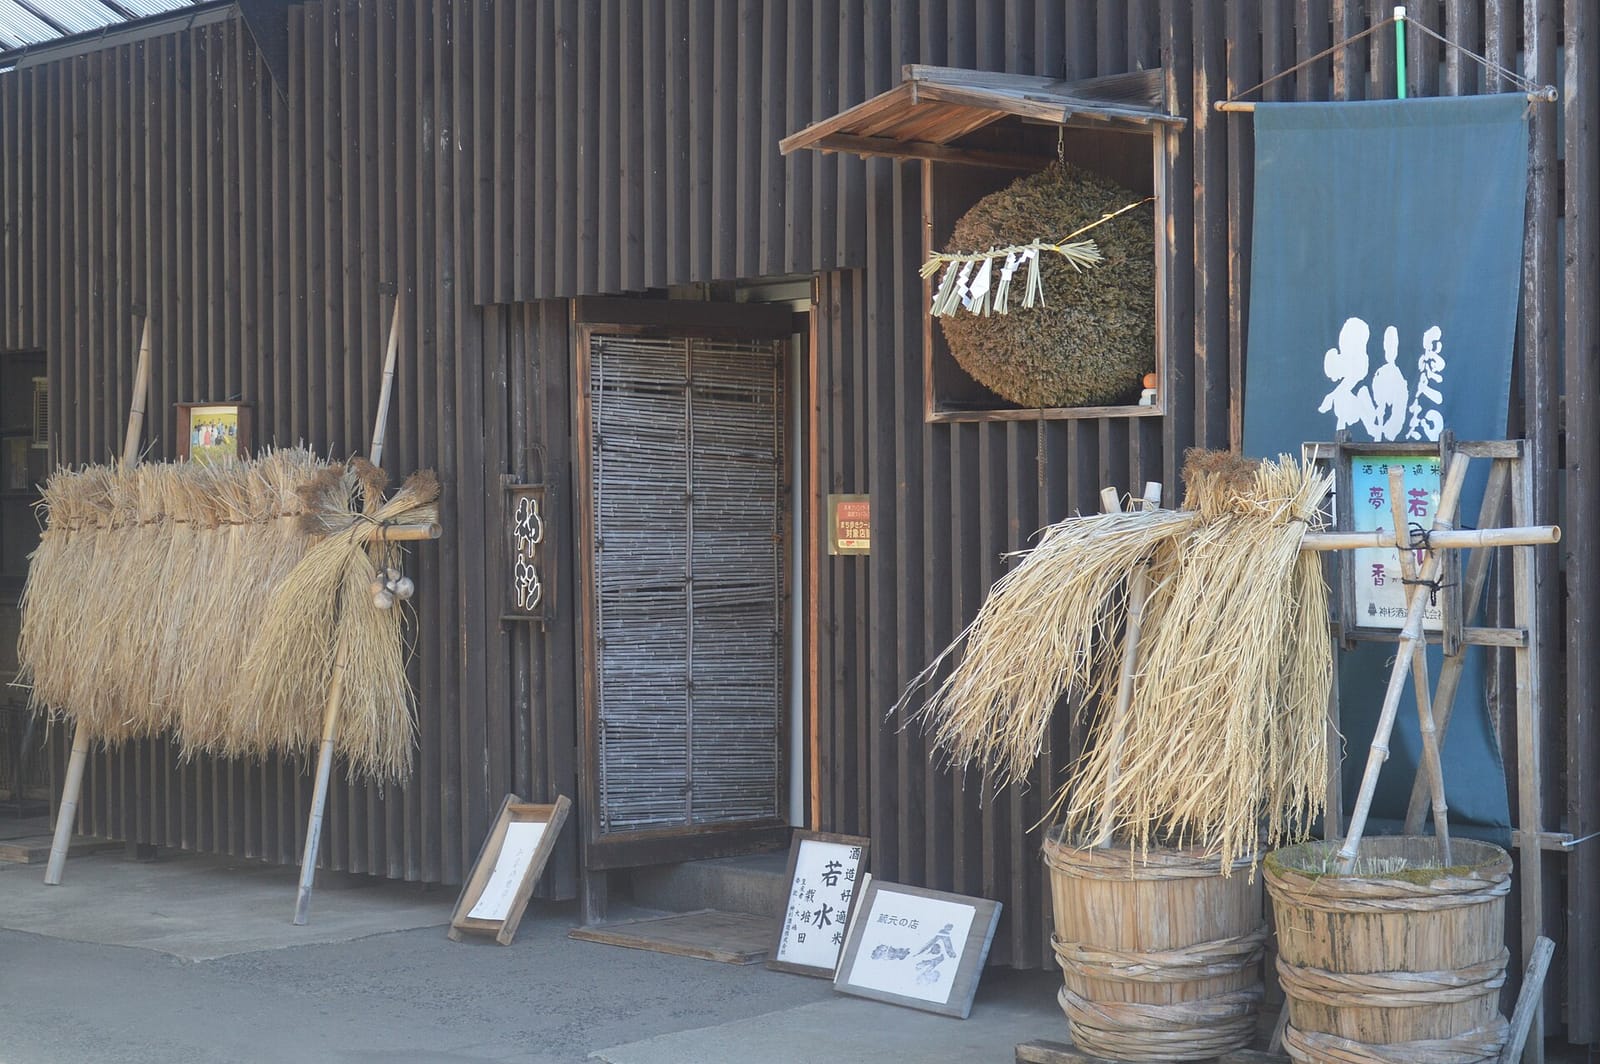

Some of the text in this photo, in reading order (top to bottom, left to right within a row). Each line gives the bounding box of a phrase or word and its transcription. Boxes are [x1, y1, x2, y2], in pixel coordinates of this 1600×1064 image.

[1362, 464, 1441, 476] 酒造適米
[1368, 486, 1387, 587] 夢香
[797, 888, 816, 944] 栽培田
[811, 860, 842, 930] 若水
[831, 847, 861, 945] 酒造好適米
[877, 913, 920, 930] 蔵元の店
